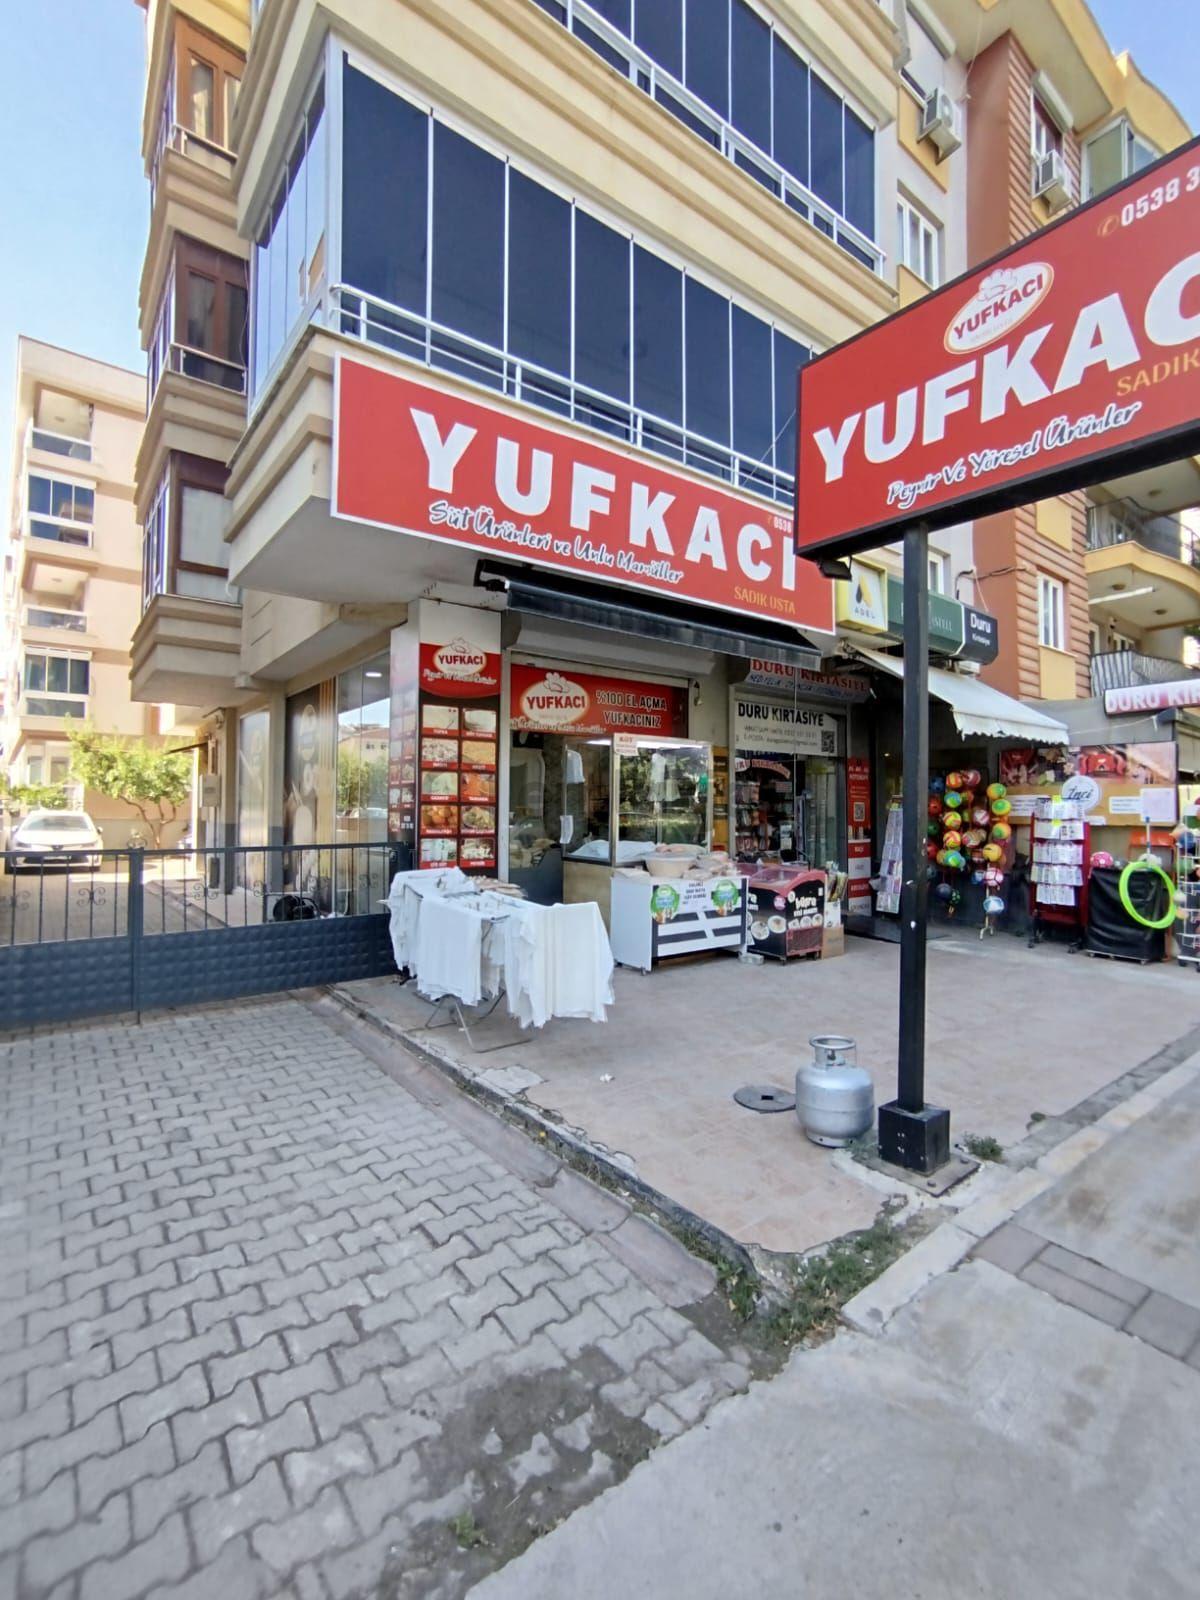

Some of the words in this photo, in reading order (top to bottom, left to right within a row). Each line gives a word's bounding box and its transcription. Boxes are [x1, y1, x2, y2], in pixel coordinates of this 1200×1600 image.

[1121, 177, 1180, 227] 0538
[953, 274, 1044, 340] YUFKACI
[887, 473, 942, 509] Peynir
[943, 457, 966, 484] Ve
[967, 430, 1041, 479] Yöresel
[1043, 400, 1142, 452] Ürünler
[409, 407, 796, 592] YUFKACI
[428, 500, 471, 531] Süt
[473, 504, 551, 551] Ürünleri
[554, 540, 572, 557] ve
[573, 535, 615, 568] Unlu
[734, 585, 767, 609] SADIK
[769, 594, 796, 615] USTA
[970, 612, 991, 634] Duru
[438, 654, 483, 665] YUFKACI
[752, 659, 794, 677] DURU
[526, 694, 586, 711] YUFKACI
[595, 689, 623, 707] %100
[625, 693, 639, 709] EL
[639, 696, 668, 713] AÇMA
[738, 702, 769, 720] DURU
[1106, 687, 1160, 713] DURU
